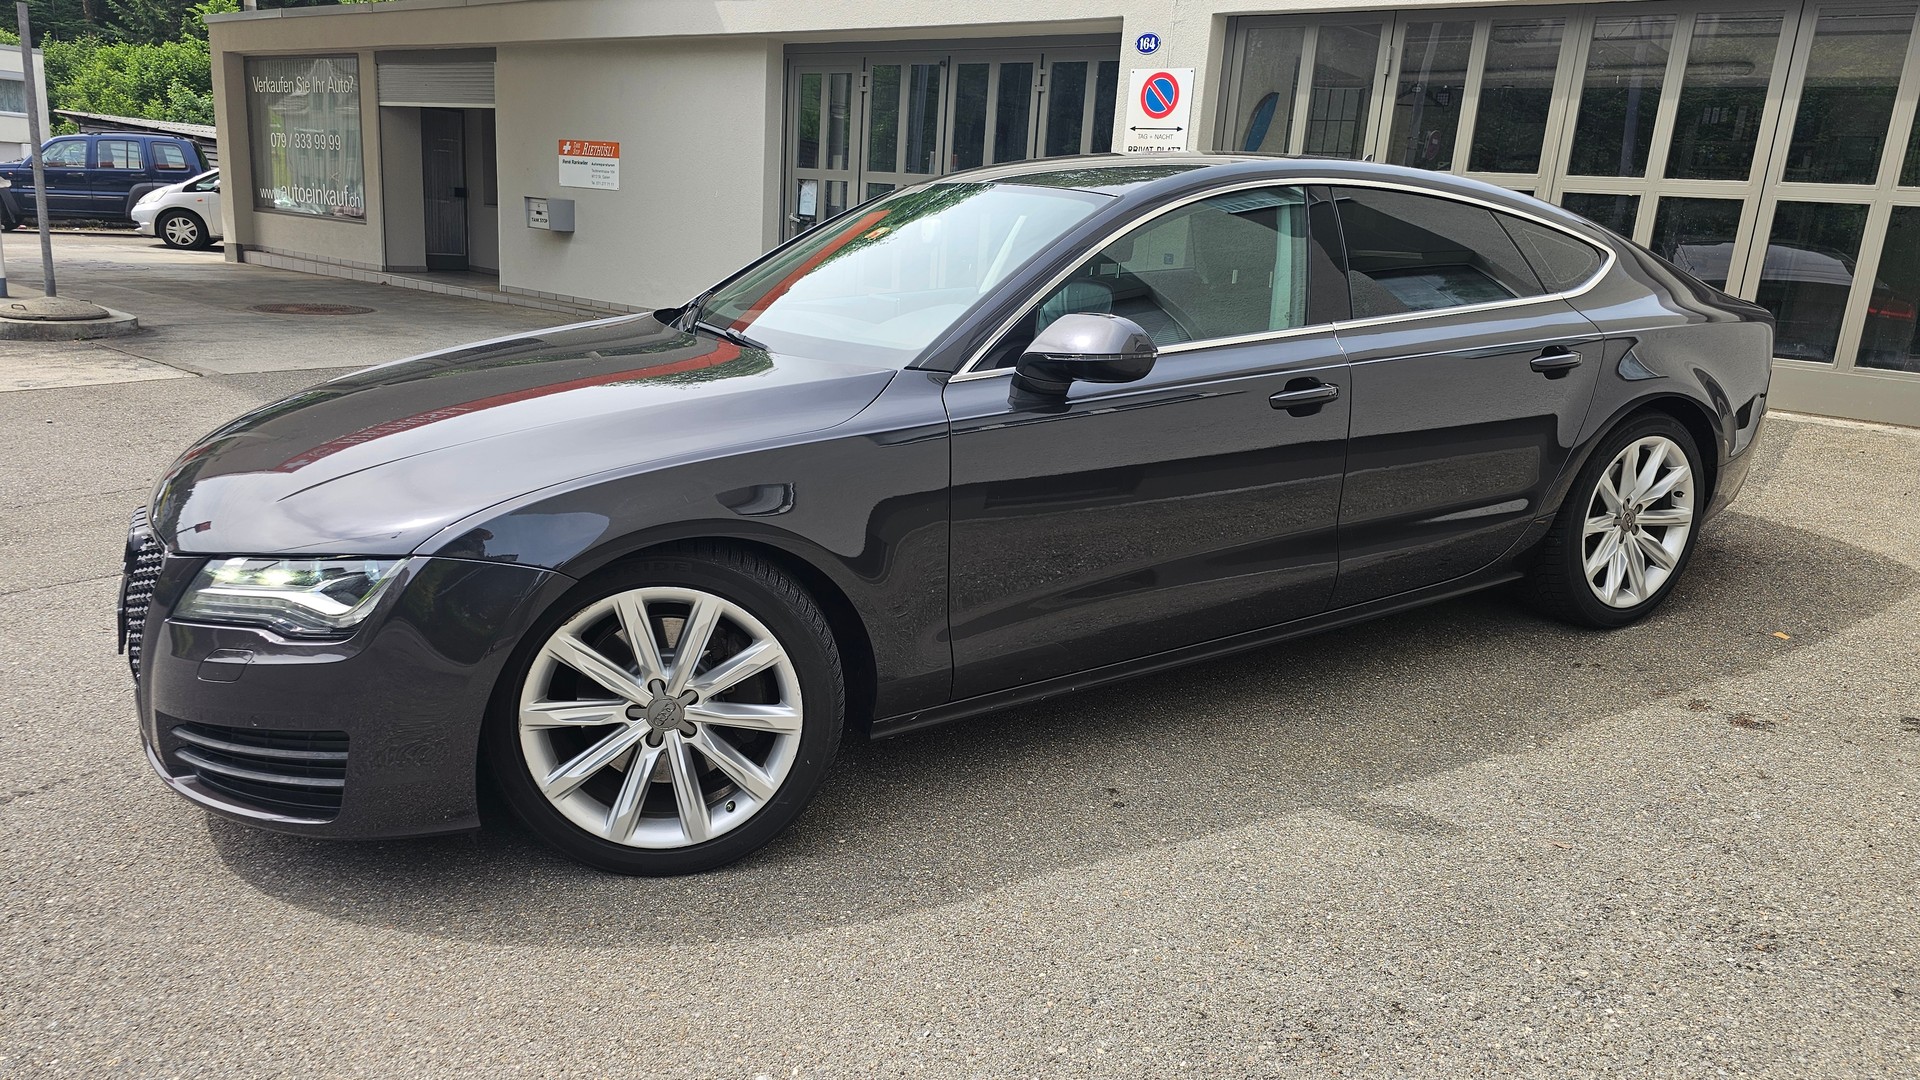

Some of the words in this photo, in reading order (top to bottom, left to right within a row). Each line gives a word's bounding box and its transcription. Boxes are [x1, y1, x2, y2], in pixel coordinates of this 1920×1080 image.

[1139, 37, 1155, 50] 164
[253, 76, 294, 93] Verkaufen
[296, 76, 310, 93] Sie
[313, 76, 325, 93] Ihr
[327, 75, 354, 93] Auto?
[270, 132, 287, 147] 079
[295, 133, 312, 149] 333
[314, 134, 326, 150] 99
[329, 134, 341, 150] 99
